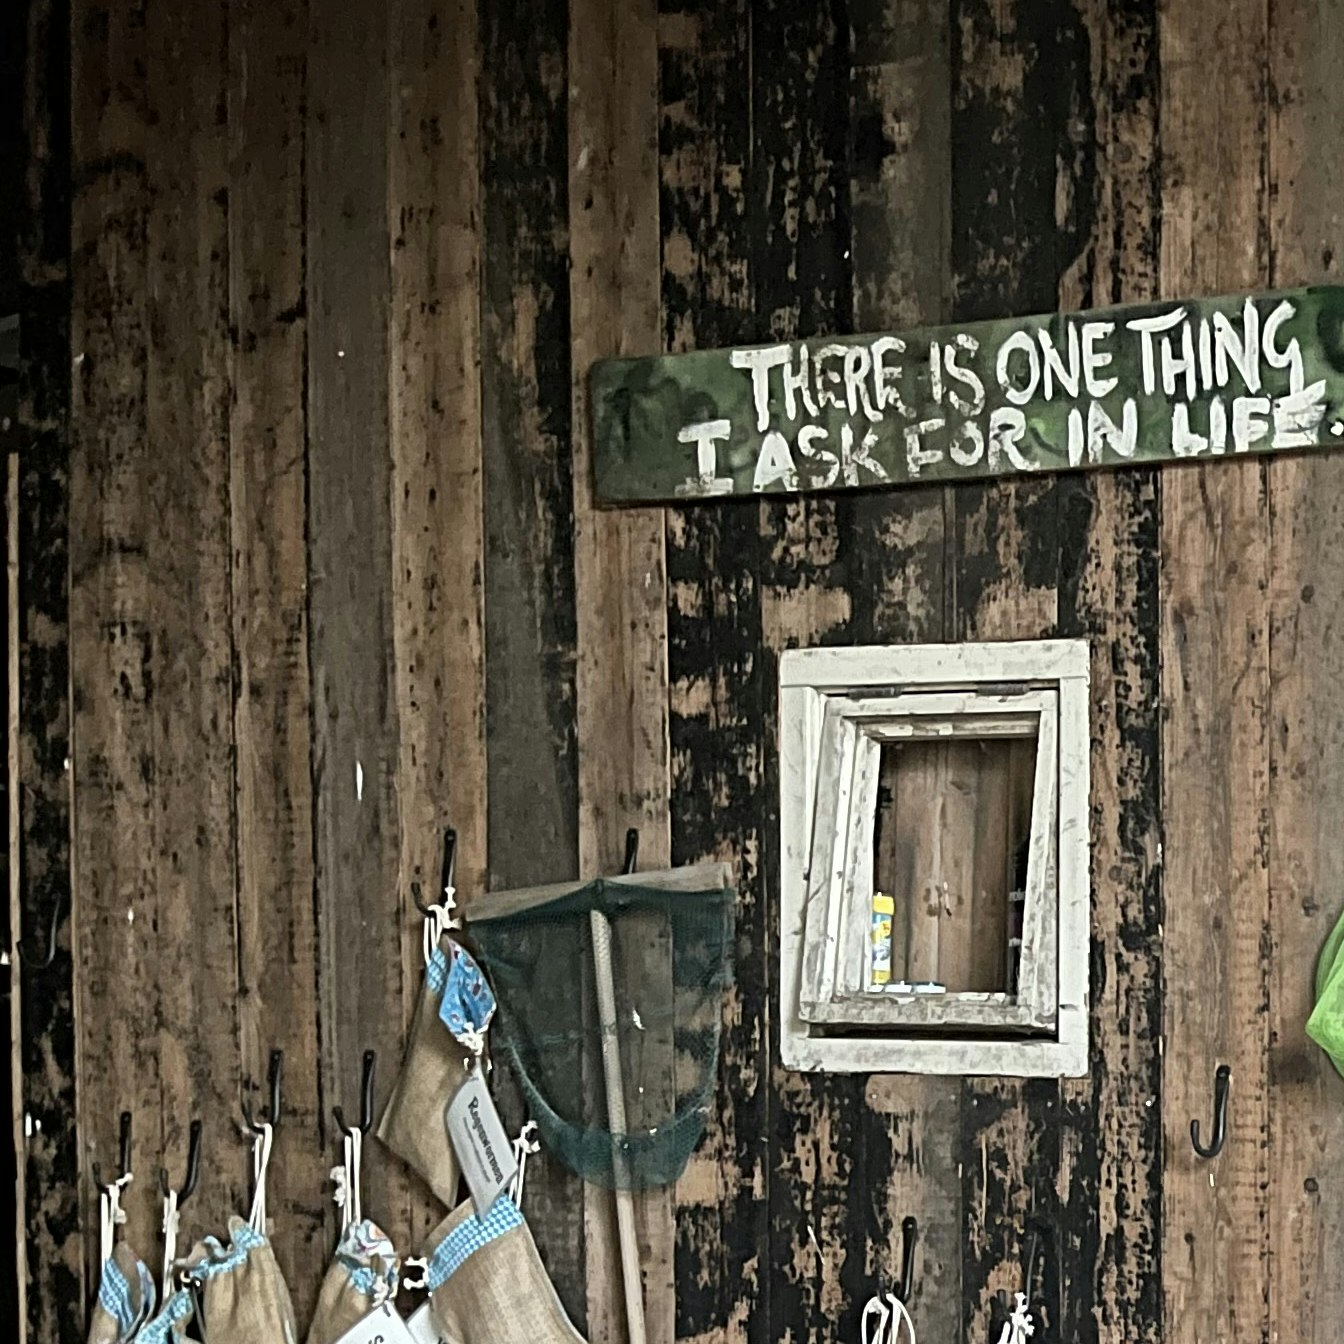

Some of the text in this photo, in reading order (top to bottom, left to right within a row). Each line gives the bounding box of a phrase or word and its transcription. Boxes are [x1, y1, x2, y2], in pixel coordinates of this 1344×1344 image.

[730, 296, 1306, 432] THERE IS ONE THING
[674, 419, 735, 497] I
[752, 422, 893, 492] ASK
[903, 406, 1041, 479] FOR
[1067, 397, 1138, 468] IN
